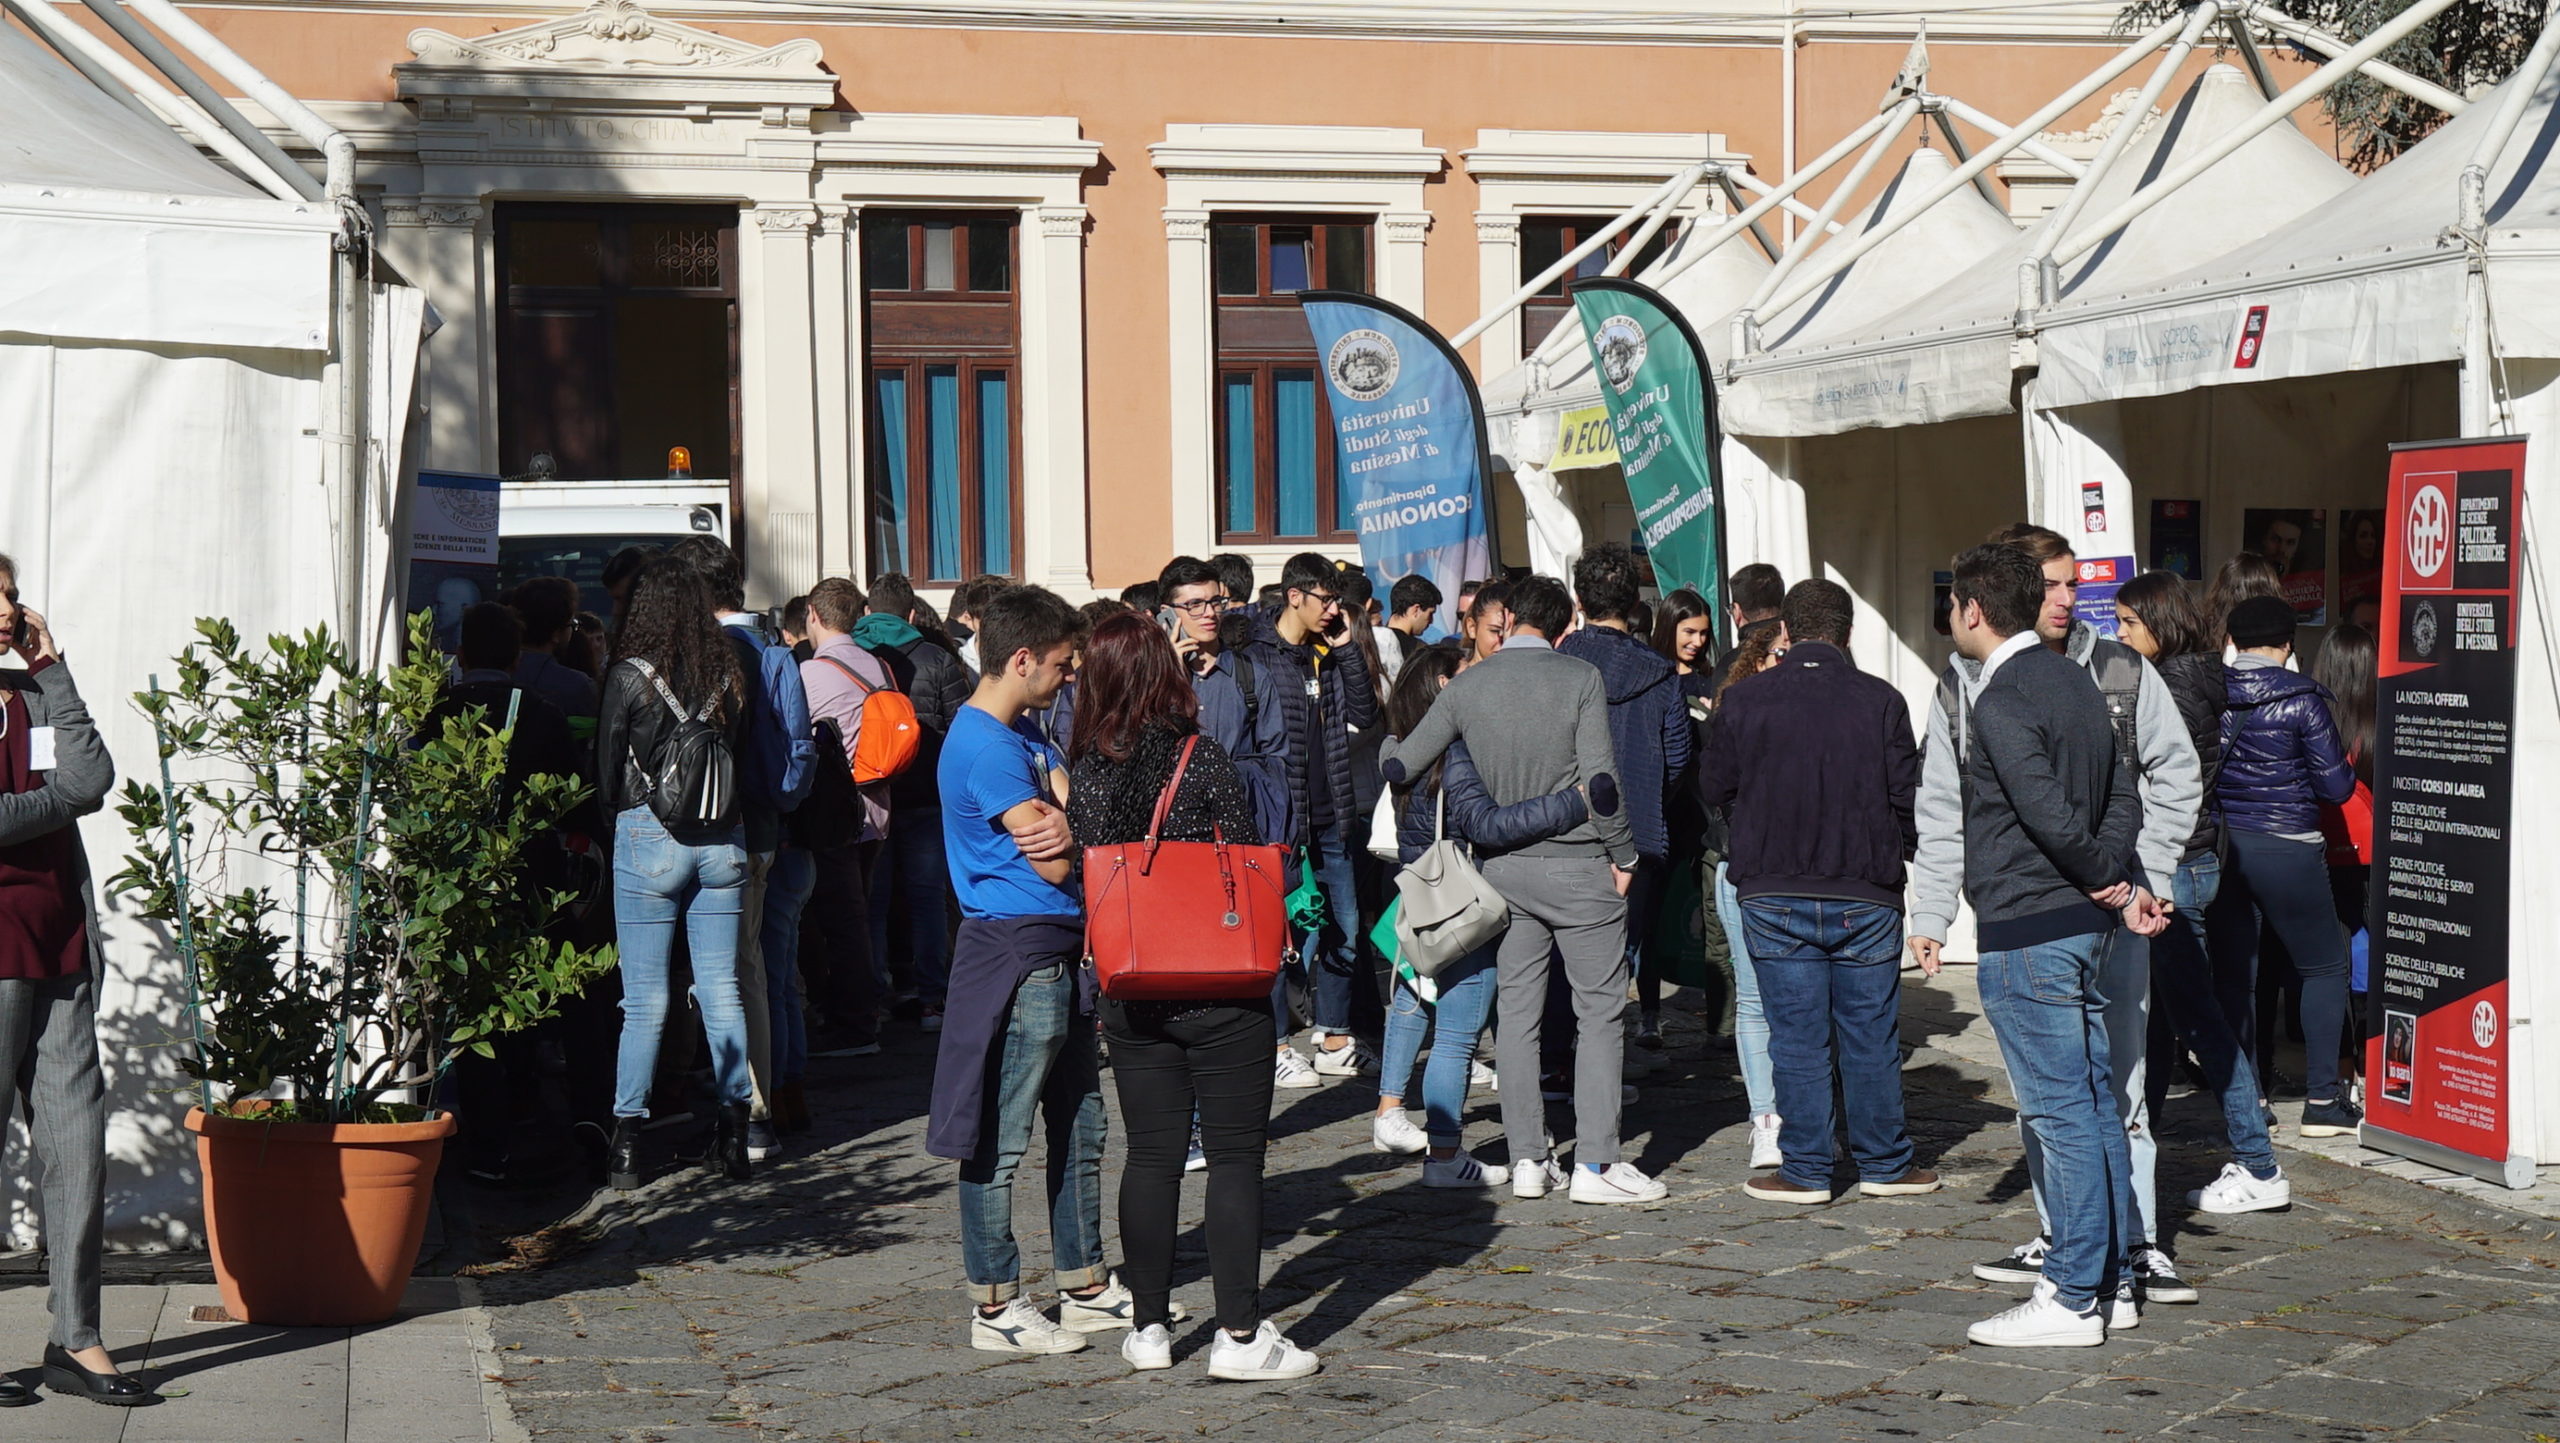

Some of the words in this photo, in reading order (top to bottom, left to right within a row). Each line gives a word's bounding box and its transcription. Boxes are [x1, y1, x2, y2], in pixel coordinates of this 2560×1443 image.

[631, 119, 729, 143] CHIMICA
[1575, 417, 1616, 455] ECO
[2459, 526, 2497, 544] POLITICHE
[2458, 545, 2464, 562] E
[2465, 544, 2506, 562] GIURIDICHE
[2455, 633, 2464, 650] DI
[2465, 634, 2498, 651] MESSINA
[2396, 690, 2404, 703] LA
[2406, 691, 2434, 705] NOSTRA
[2434, 693, 2469, 708] OFFERTA
[2396, 777, 2420, 791] NOSTRI
[2421, 779, 2443, 794] CORSI
[2444, 781, 2453, 795] DI
[2454, 782, 2485, 799] LAUREA
[2391, 801, 2416, 815] SCIENZE
[2416, 804, 2447, 818] POLITICHE
[2391, 815, 2396, 826] E
[2396, 816, 2413, 828] DELLE
[2414, 818, 2444, 832] RELAZIONI
[2445, 822, 2501, 840] INTERNAZIONALI
[2389, 856, 2413, 871] SCIENZE
[2388, 870, 2444, 890] AMMINISTRAZIONE
[2444, 879, 2449, 891] E
[2450, 879, 2474, 894] SERVIZI
[2387, 911, 2417, 927] RELAZIONI
[2418, 917, 2471, 937] INTERNAZIONALI
[2385, 953, 2410, 968] SCIENZE
[2410, 958, 2429, 972] DELLE
[2429, 962, 2465, 980] PUBBLICHE
[2384, 967, 2439, 988] AMMINISTRAZIONI
